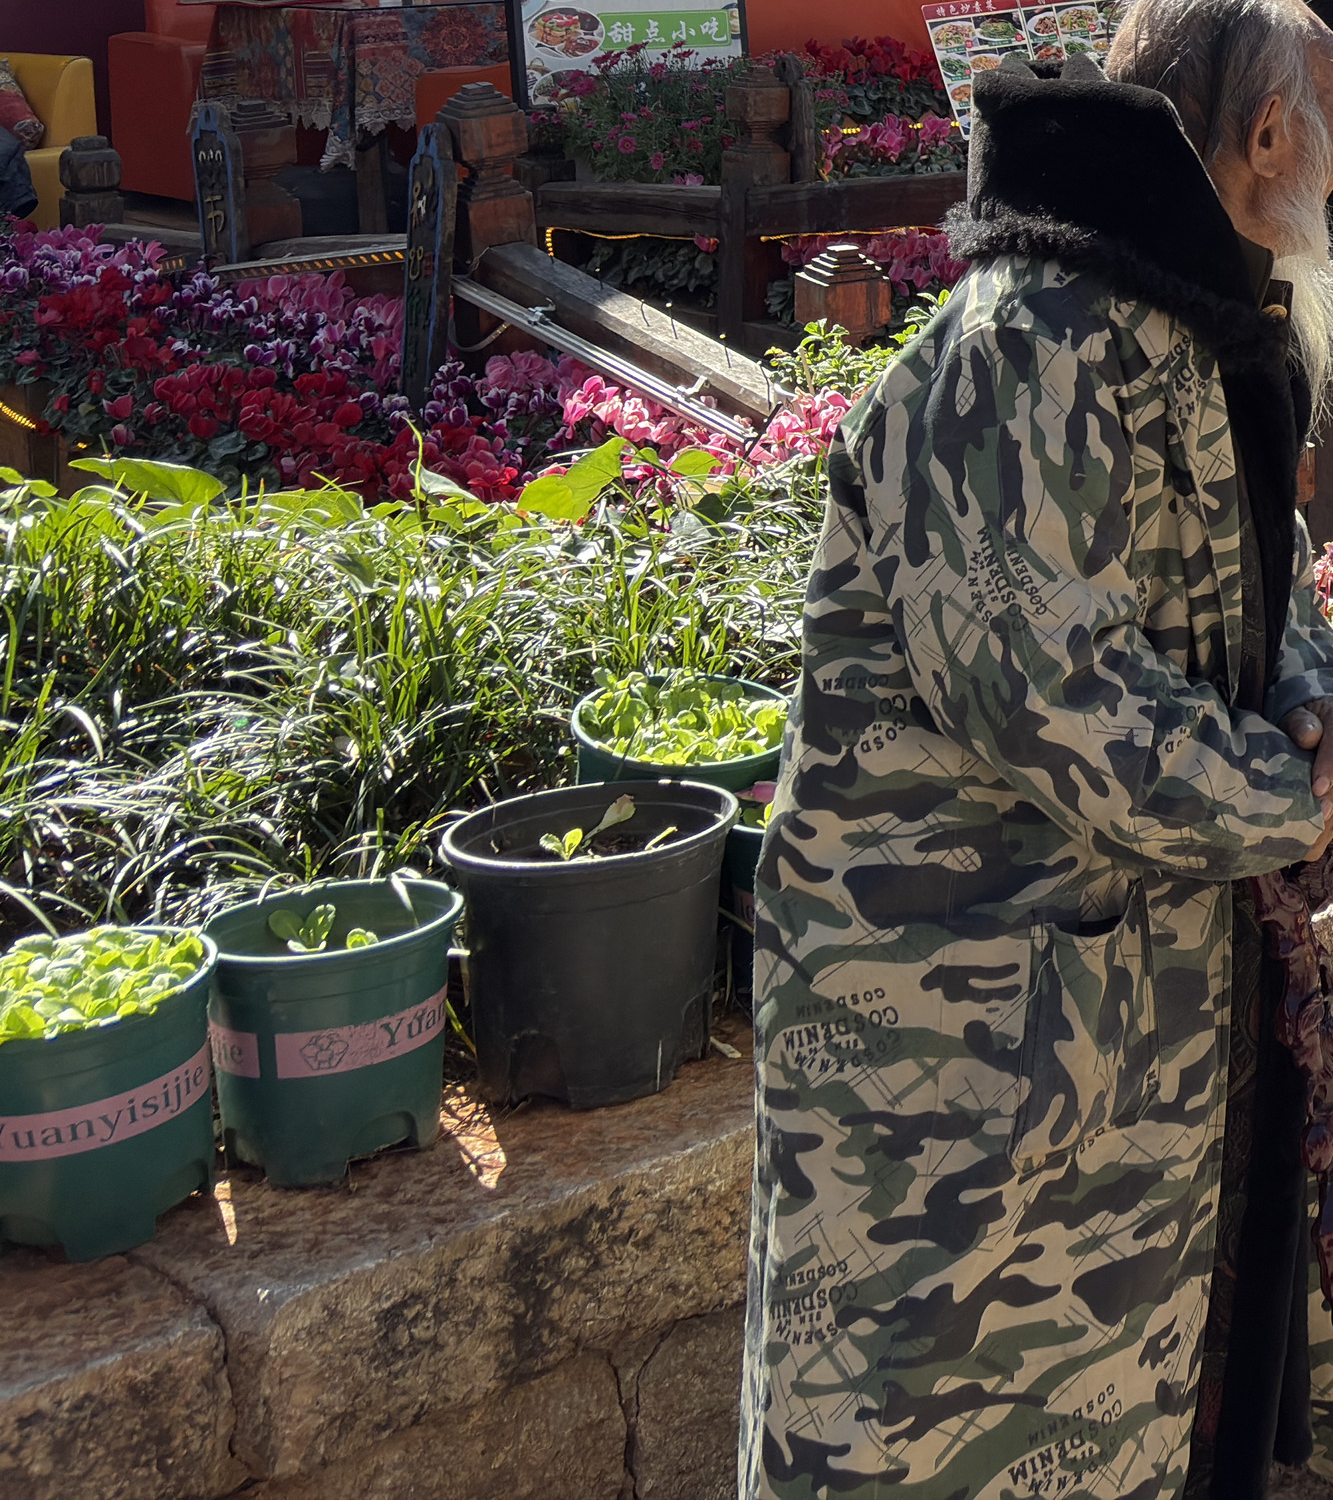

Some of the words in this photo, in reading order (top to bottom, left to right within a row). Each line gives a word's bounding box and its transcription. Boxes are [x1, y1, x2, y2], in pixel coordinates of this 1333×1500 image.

[606, 16, 728, 44] 甜点小吃
[783, 1005, 899, 1053] COSDENIM
[1008, 1399, 1122, 1486] COSDENIM
